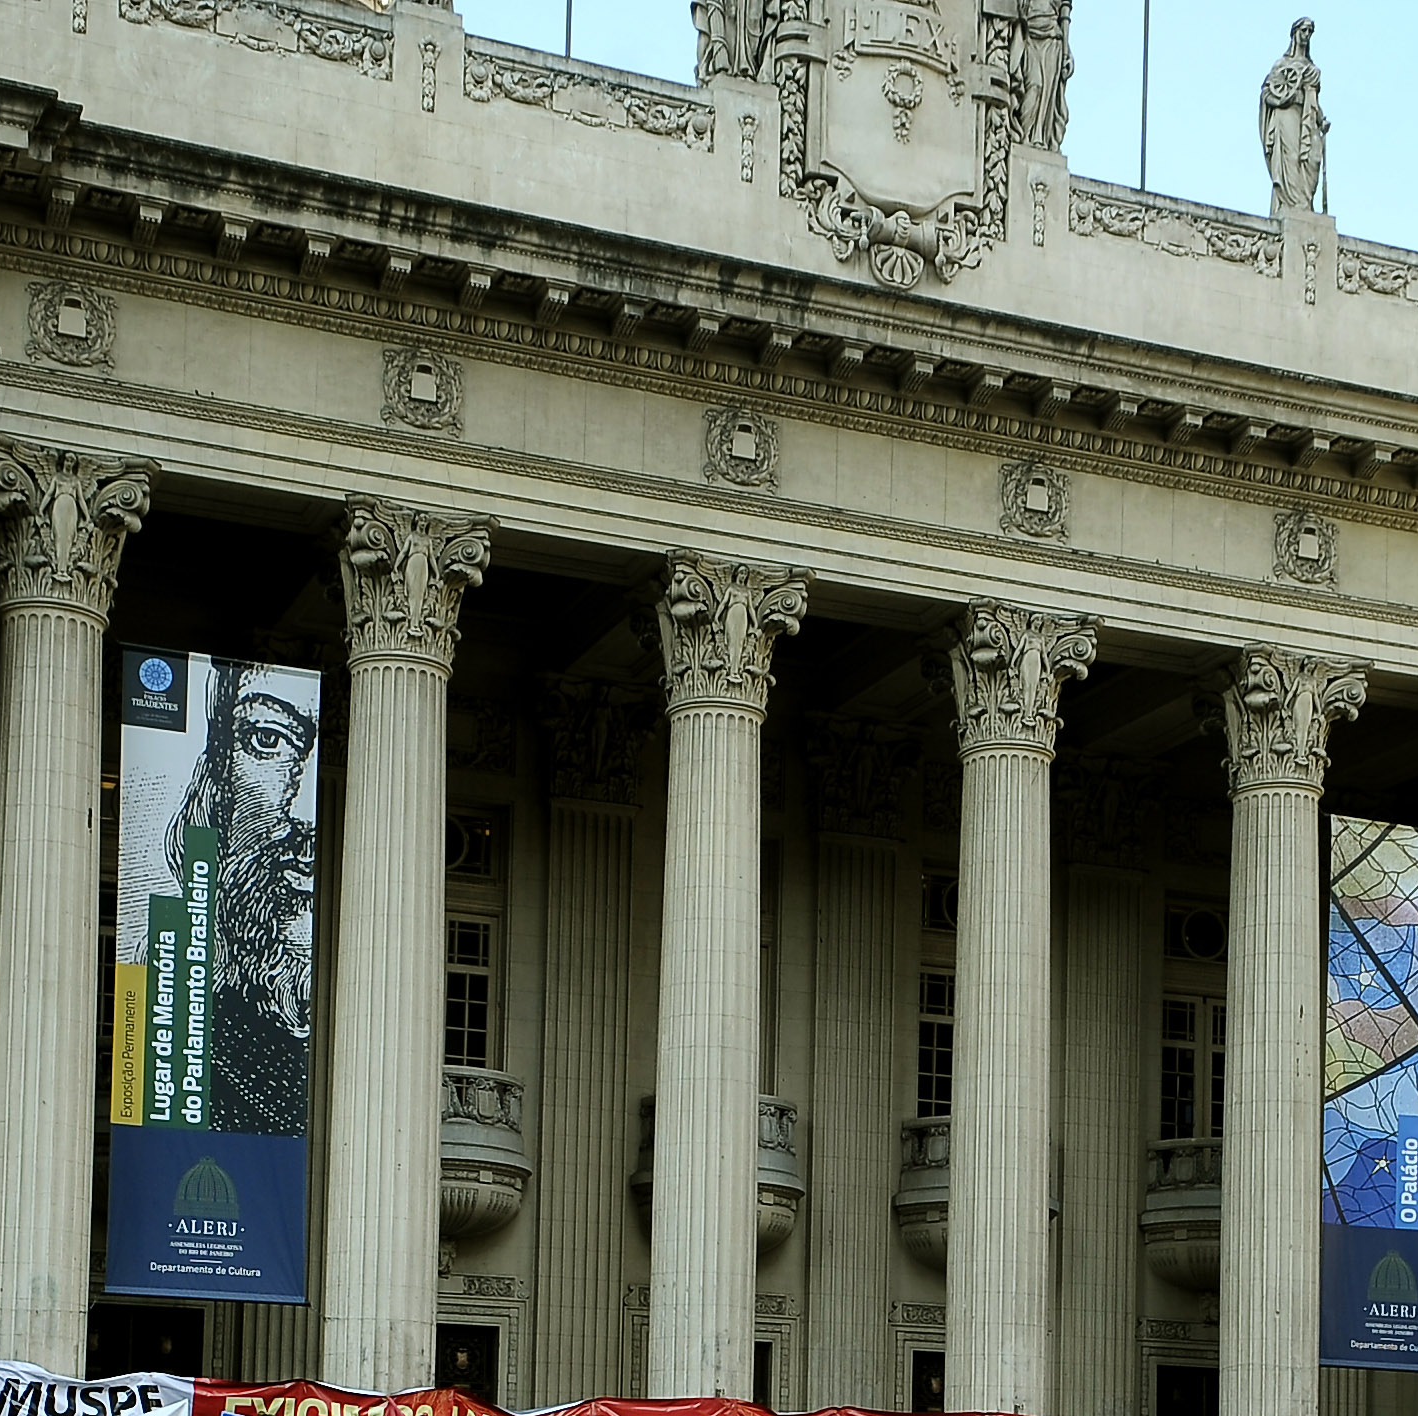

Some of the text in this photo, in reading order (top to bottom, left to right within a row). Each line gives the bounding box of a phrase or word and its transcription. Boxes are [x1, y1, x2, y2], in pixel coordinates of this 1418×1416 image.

[871, 11, 943, 58] LEX
[181, 860, 209, 1124] do Parlamento Brasileiro
[120, 990, 136, 1119] Exposição Permanente
[150, 930, 175, 1122] Lugar de Memória
[1401, 1137, 1418, 1223] O Palácio
[176, 1219, 237, 1236] ALERJ
[150, 1262, 261, 1277] Departamento de Cultura
[1369, 1303, 1417, 1318] ALERJ
